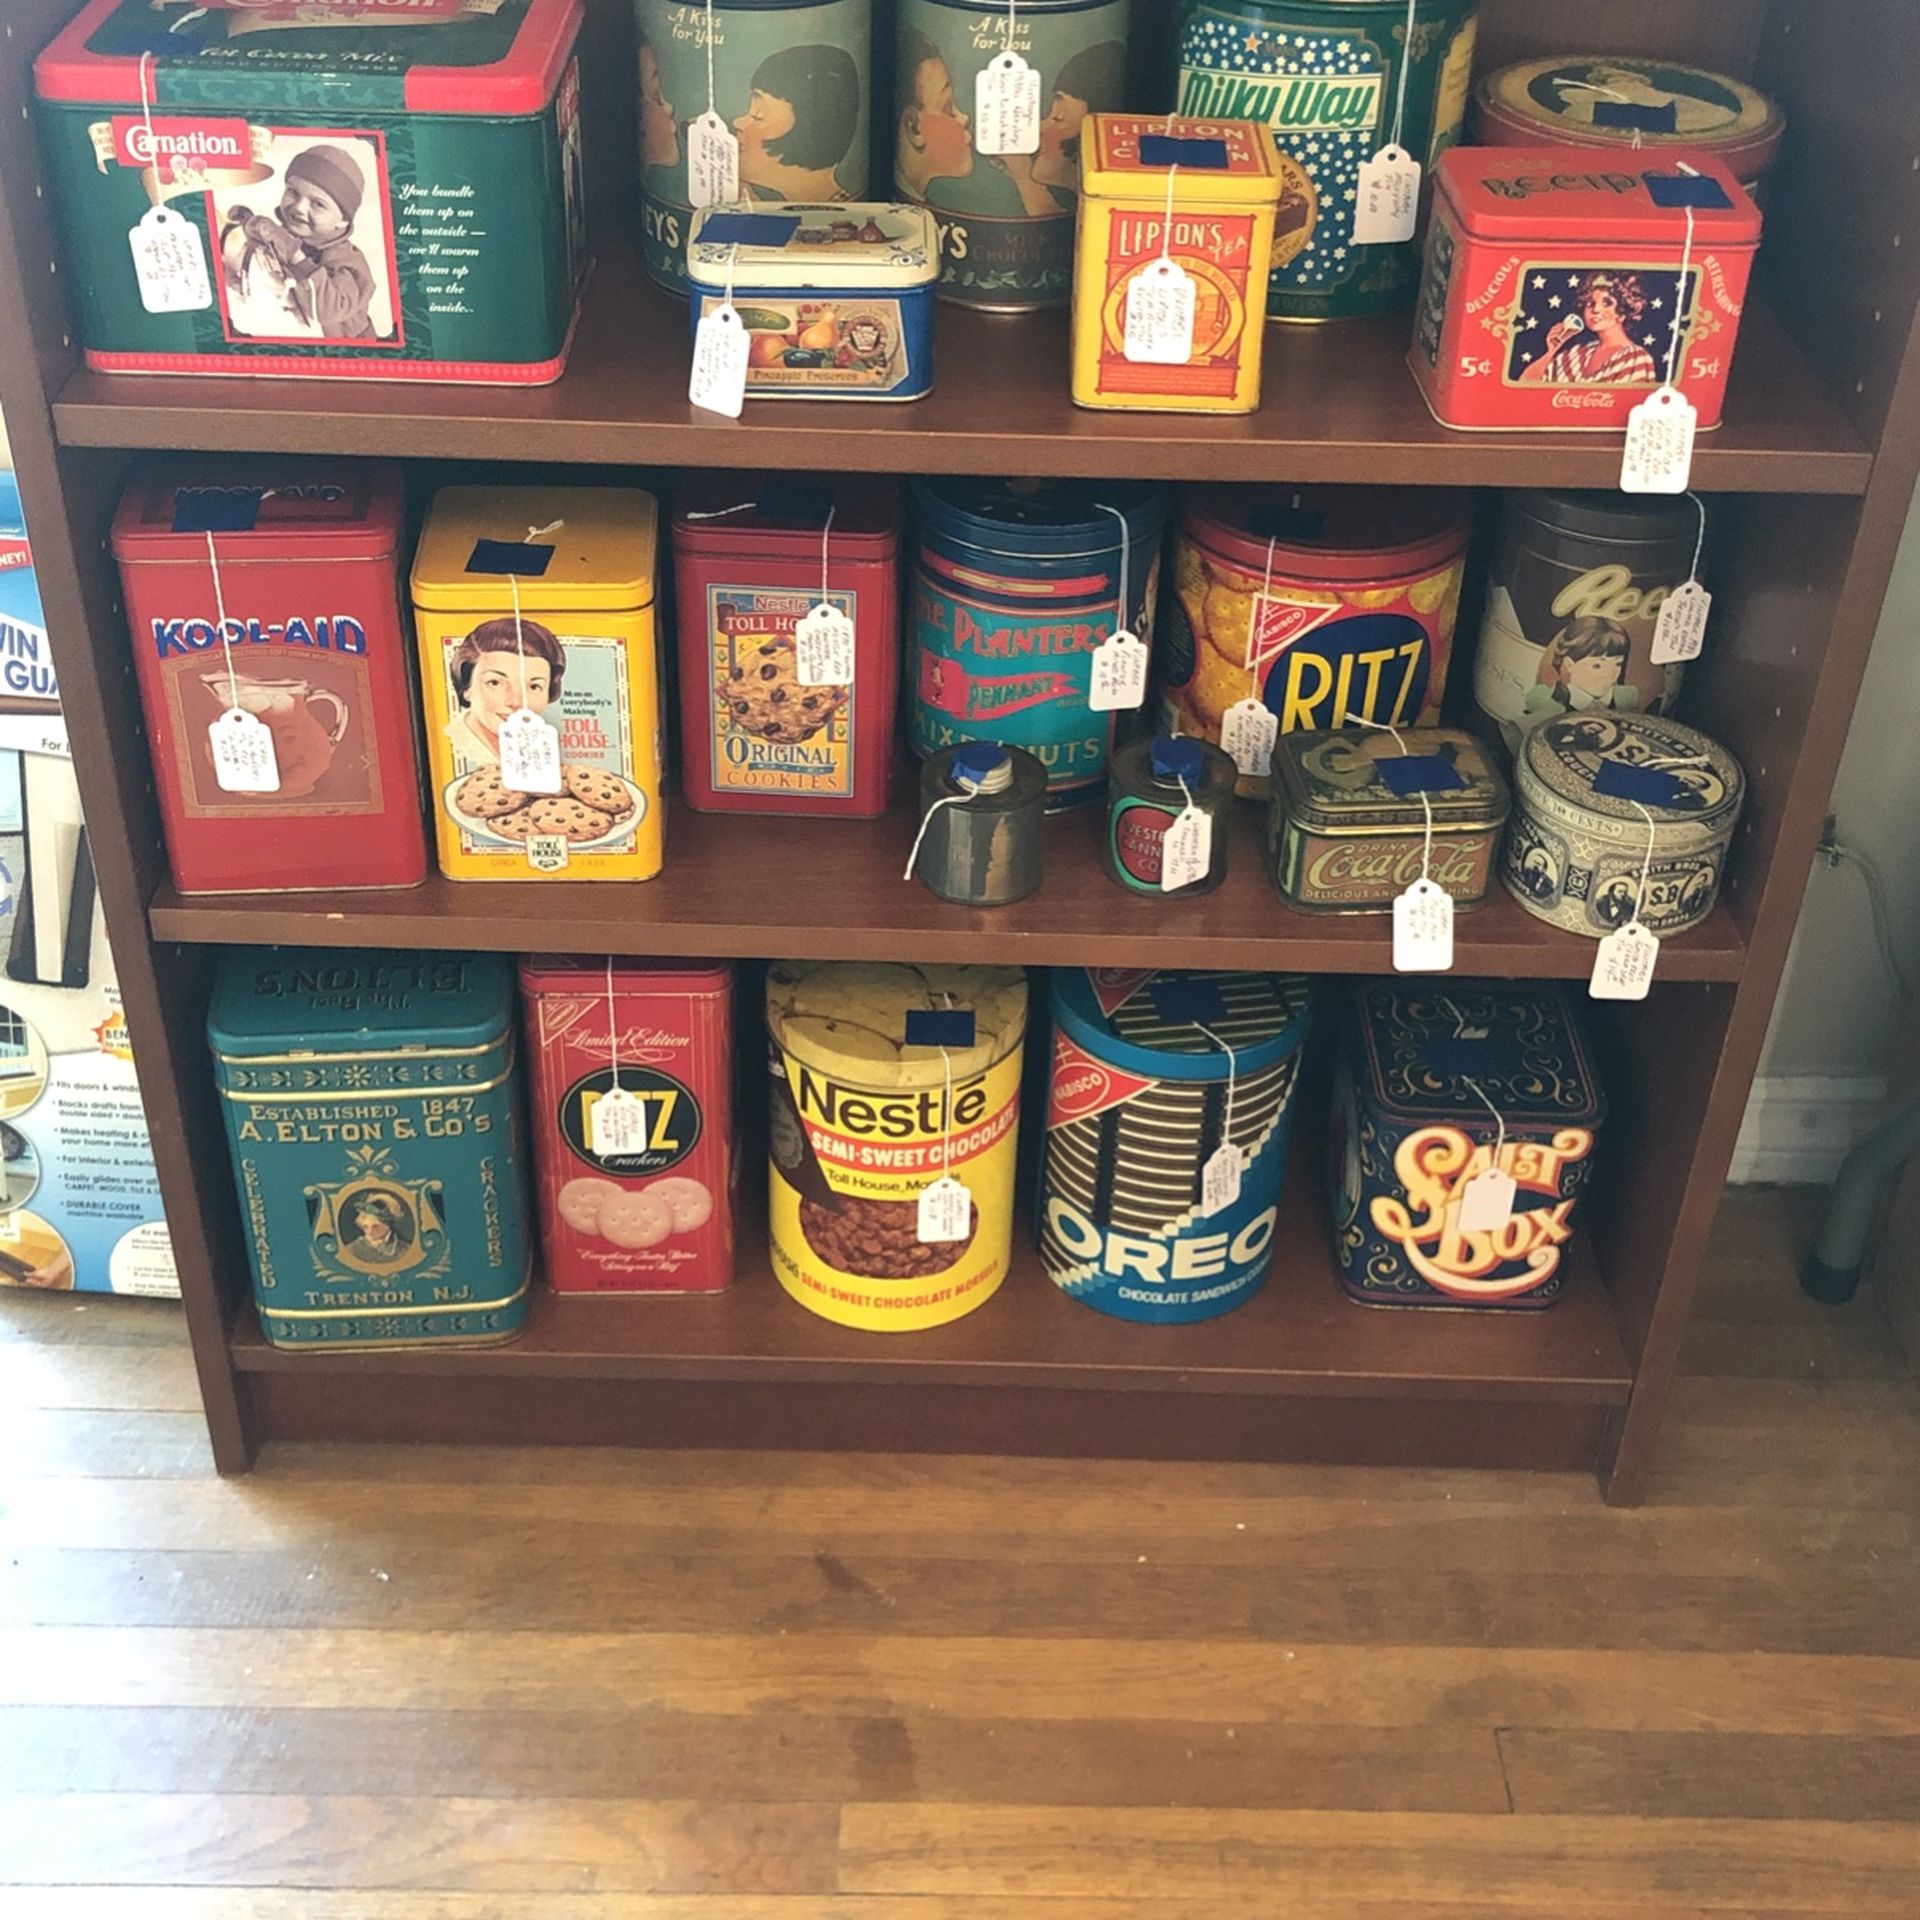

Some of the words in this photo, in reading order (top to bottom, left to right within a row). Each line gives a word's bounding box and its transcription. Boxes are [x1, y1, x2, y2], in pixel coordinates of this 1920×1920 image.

[672, 24, 692, 40] for
[994, 18, 1030, 34] Kss
[973, 33, 996, 49] for
[399, 183, 428, 199] You
[432, 184, 475, 198] bundle
[403, 204, 435, 216] them
[437, 206, 454, 221] up
[399, 223, 418, 235] the
[422, 225, 467, 237] outside
[419, 262, 449, 275] them
[452, 265, 469, 279] up
[445, 282, 465, 294] the
[1466, 255, 1520, 315] DELICIOUS
[1703, 255, 1740, 318] REFRESHING
[1460, 357, 1492, 378] 5¢
[1690, 357, 1720, 379] 5¢
[726, 616, 768, 632] TOLL
[151, 615, 367, 658] KOOL-AID
[1280, 638, 1424, 736] RITZ
[562, 719, 603, 733] TOLL
[41, 738, 61, 750] For
[726, 737, 838, 765] ORIGINAL
[727, 771, 838, 789] COOKIES
[105, 1029, 129, 1040] BEN
[628, 1027, 690, 1047] Edition
[250, 1105, 398, 1121] ESTABLISHED
[422, 1098, 475, 1115] 1847
[60, 1127, 91, 1136] Makes
[93, 1129, 130, 1140] heating
[393, 1121, 418, 1140] &
[84, 1138, 111, 1147] home
[826, 1168, 850, 1185] Toll
[66, 1200, 106, 1209] DURABLE
[108, 1203, 141, 1212] COVER
[480, 1156, 502, 1268] CRACKERS
[242, 1159, 277, 1289] CELEBRATED
[1048, 1197, 1277, 1284] OREO
[305, 1290, 414, 1305] TRENTON
[874, 1290, 952, 1309] CHOCOLATE
[1118, 1286, 1189, 1304] CHOCOLATE
